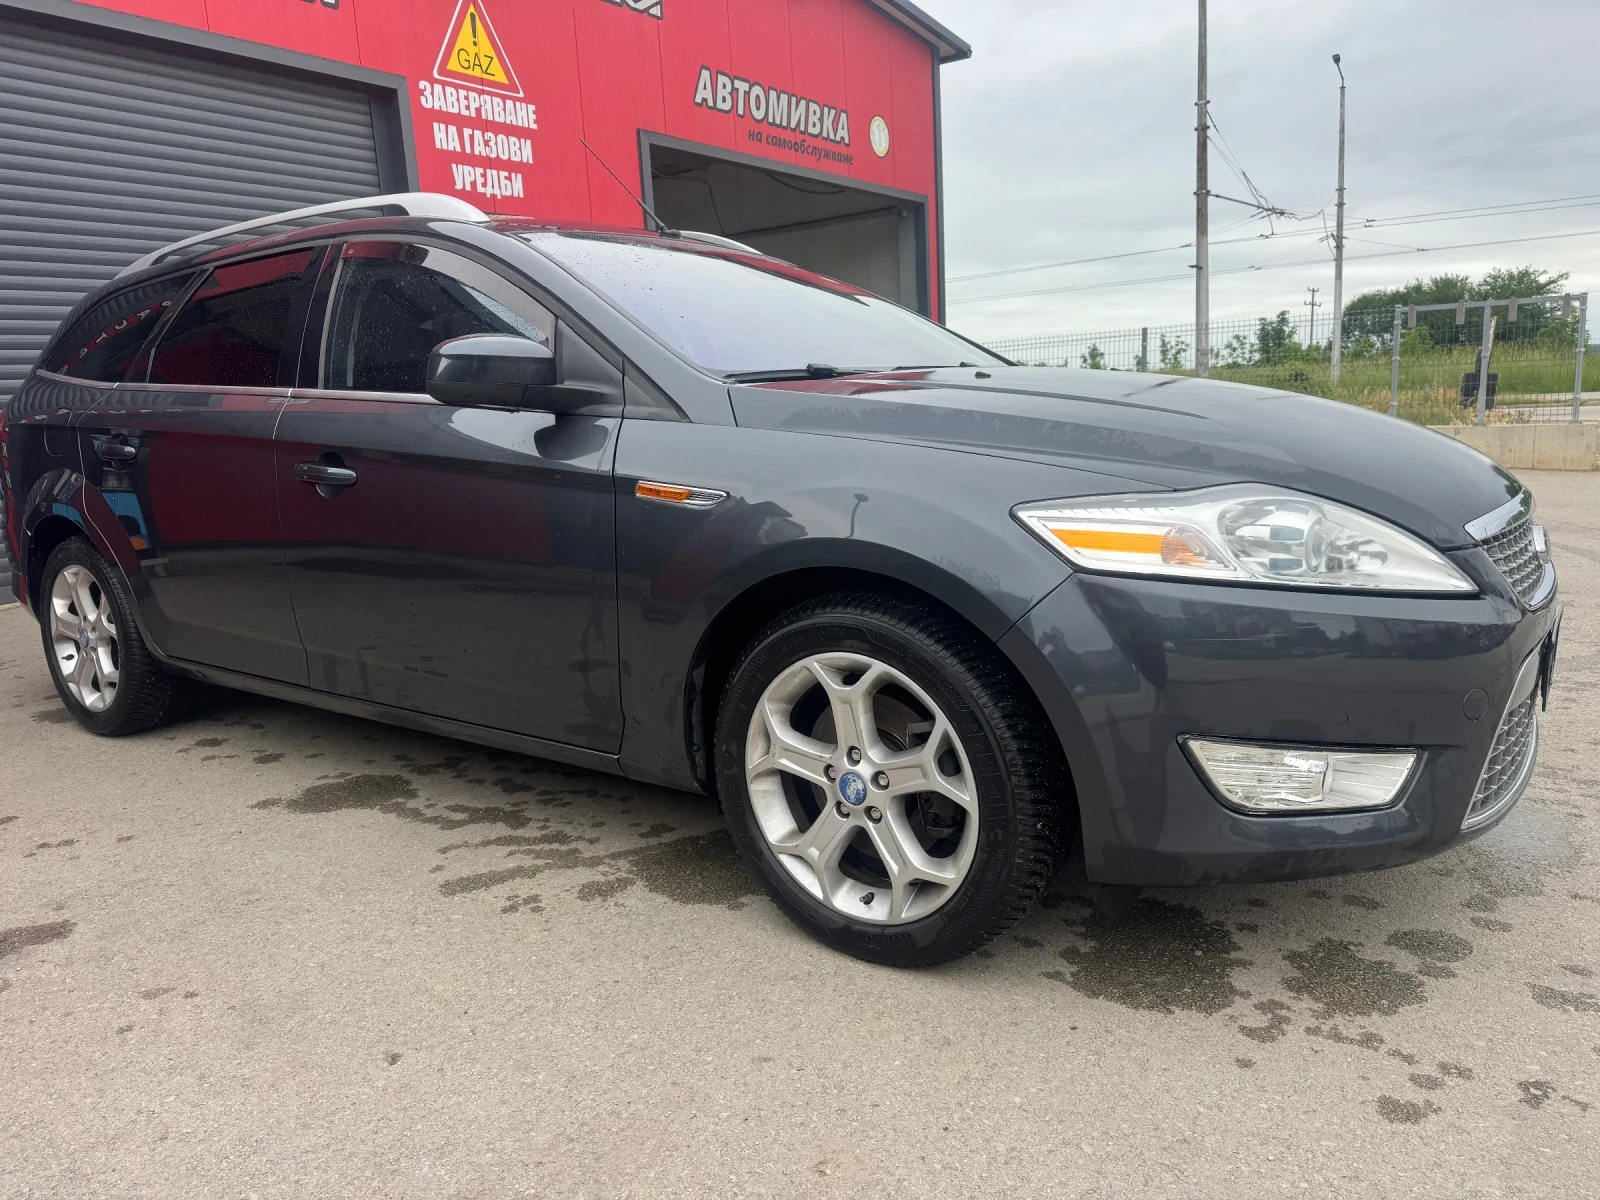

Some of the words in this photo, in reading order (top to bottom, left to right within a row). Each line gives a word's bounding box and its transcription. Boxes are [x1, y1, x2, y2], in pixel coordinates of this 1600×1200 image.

[456, 47, 496, 77] GAZ
[418, 79, 538, 130] ЗАВЕРЯВАНЕ
[694, 65, 851, 147] АВТОМИВКА
[432, 121, 462, 153] НА
[463, 127, 534, 165] ГАЗОВИ
[748, 129, 763, 144] на
[766, 134, 854, 166] самообслужване
[451, 162, 525, 200] УРЕДБИ
